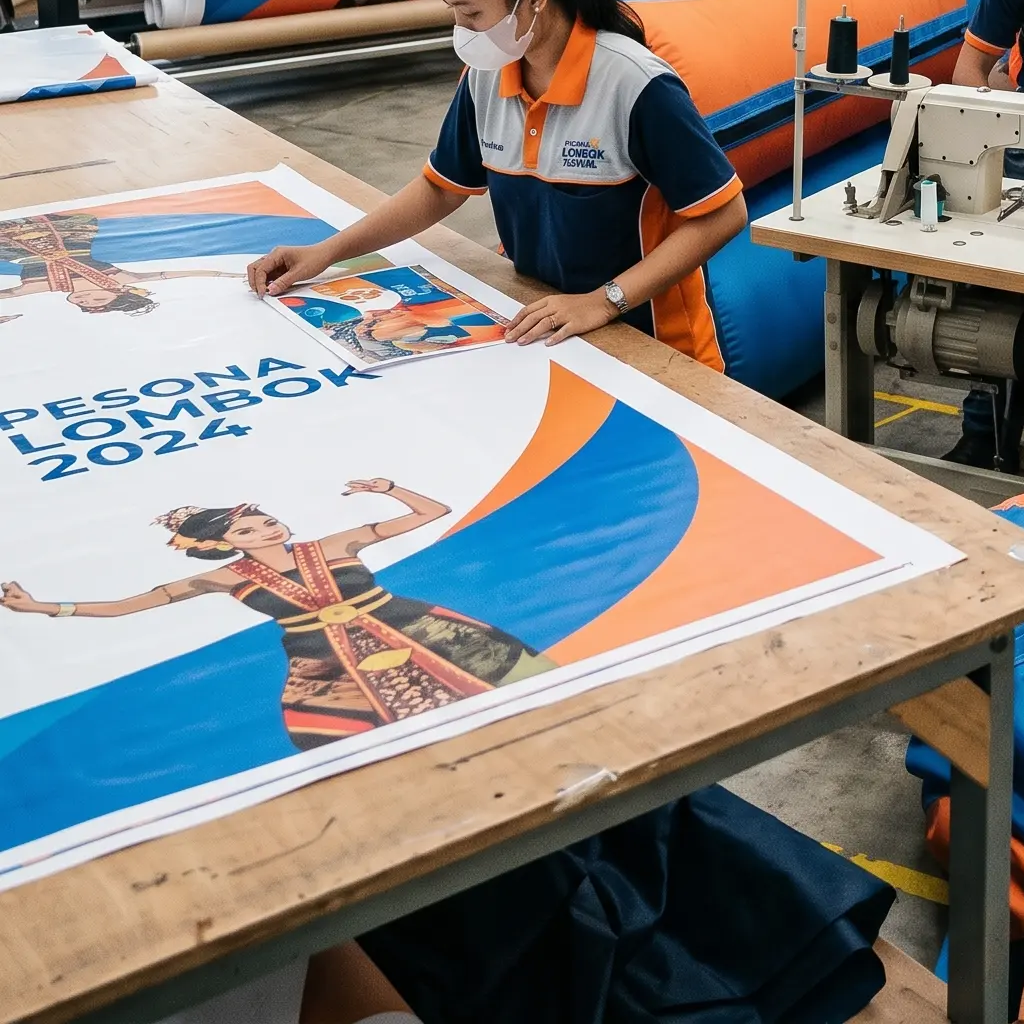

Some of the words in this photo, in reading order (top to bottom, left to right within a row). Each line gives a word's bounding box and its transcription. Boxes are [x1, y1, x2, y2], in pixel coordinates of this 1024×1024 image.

[0, 357, 306, 431] PESONA
[8, 365, 383, 455] LOMBOK
[27, 417, 253, 482] 2024
